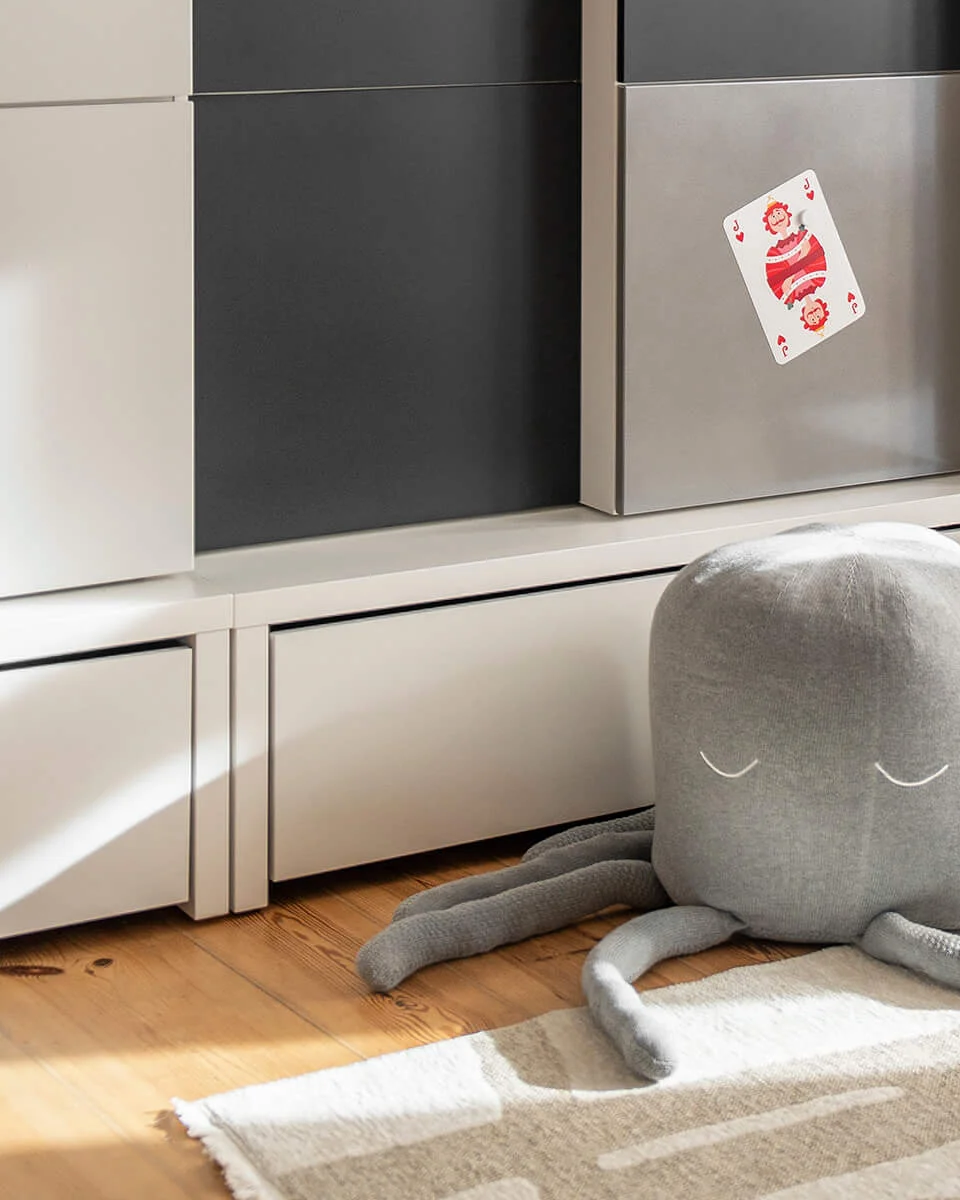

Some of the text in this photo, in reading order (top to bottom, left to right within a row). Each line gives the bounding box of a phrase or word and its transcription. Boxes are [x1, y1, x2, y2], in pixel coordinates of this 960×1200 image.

[803, 178, 810, 190] J
[732, 219, 739, 232] J
[851, 302, 858, 314] J
[782, 345, 789, 357] J
